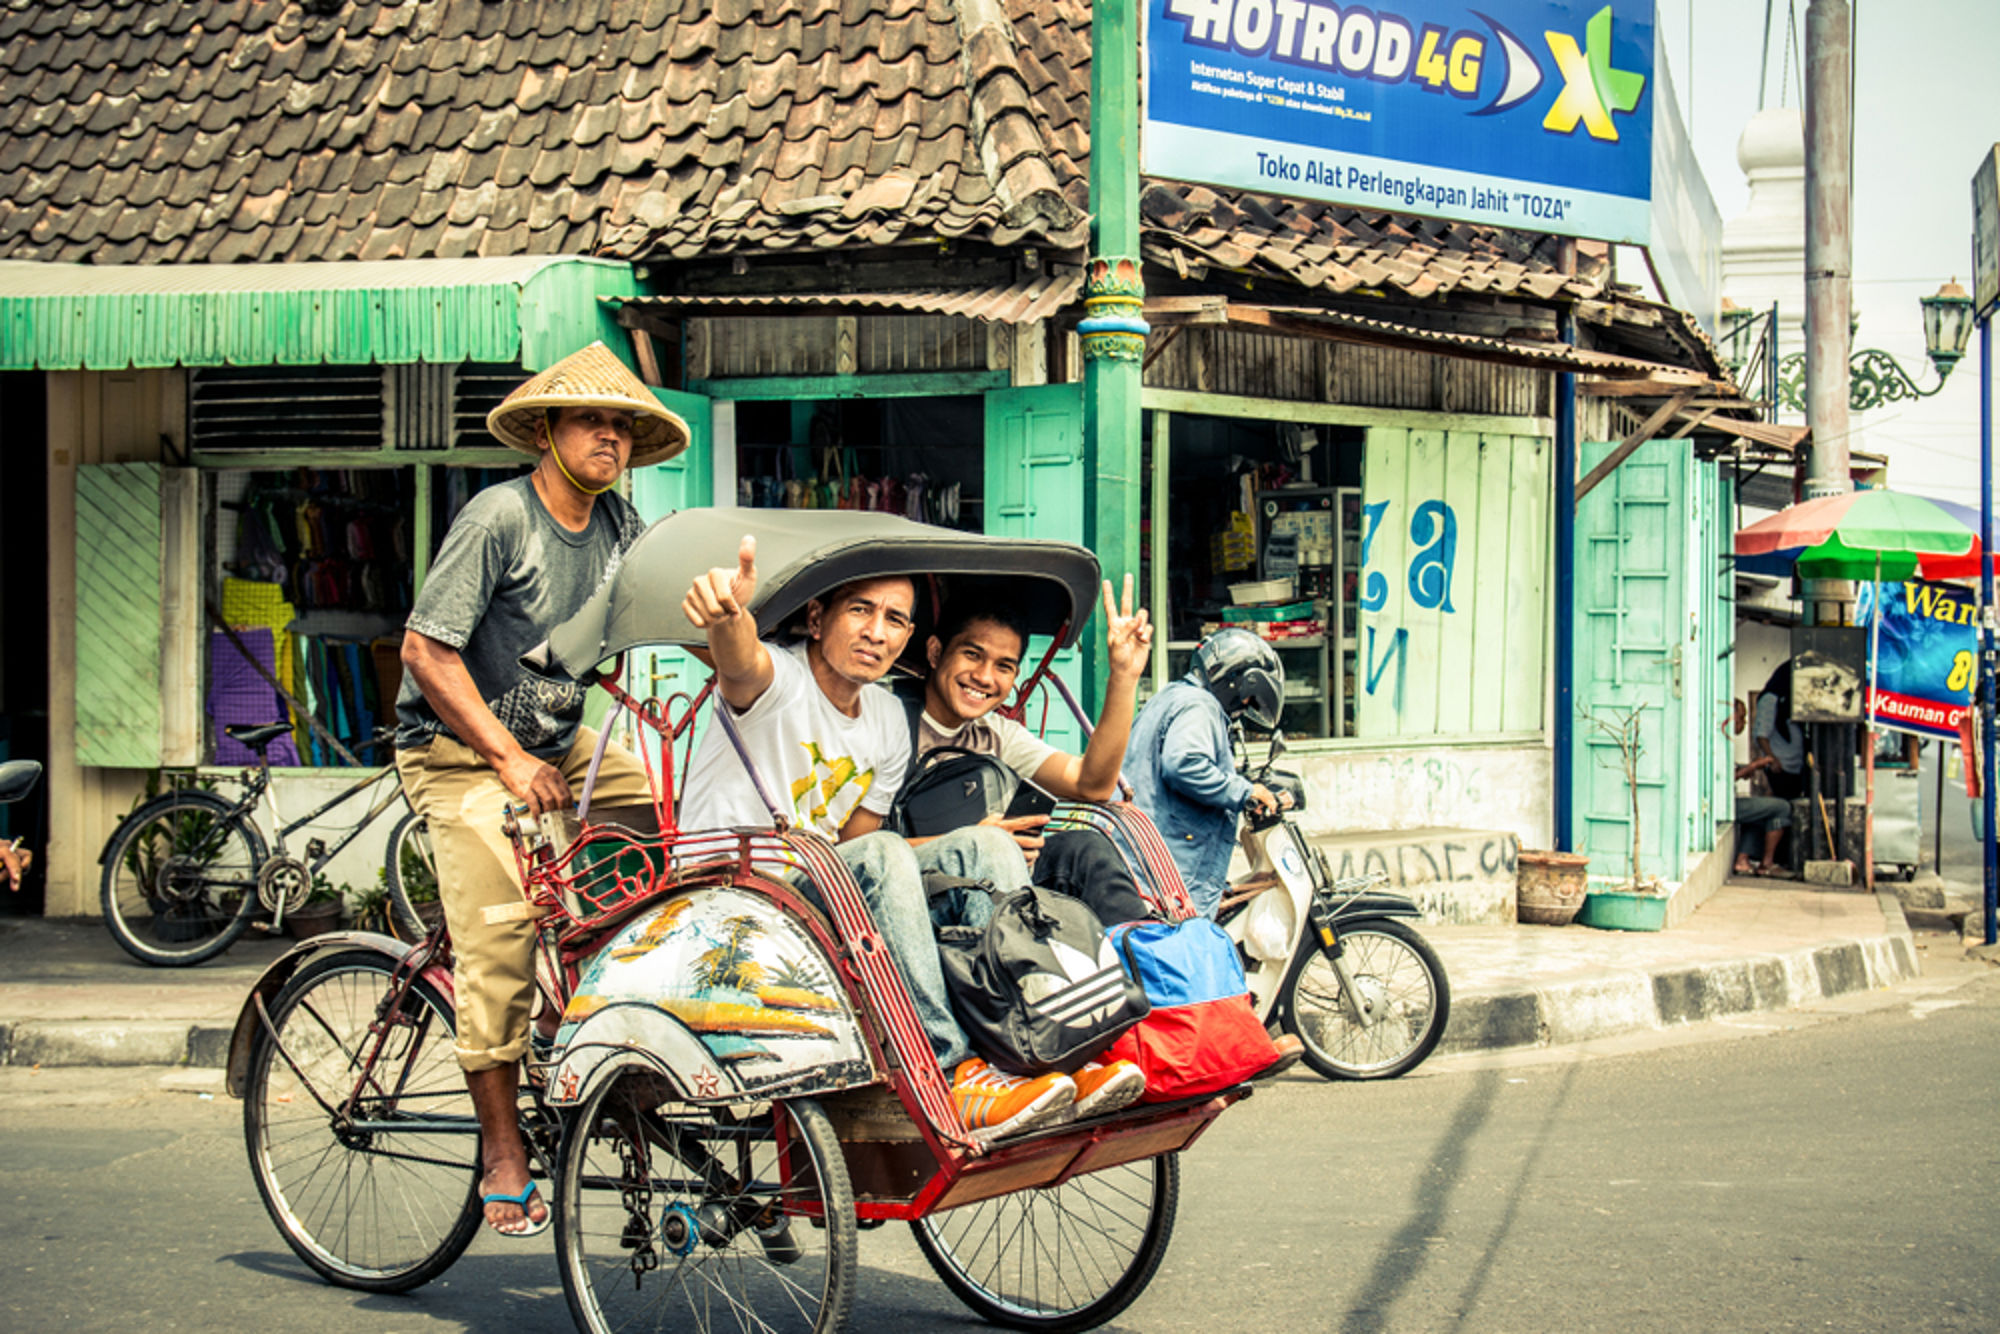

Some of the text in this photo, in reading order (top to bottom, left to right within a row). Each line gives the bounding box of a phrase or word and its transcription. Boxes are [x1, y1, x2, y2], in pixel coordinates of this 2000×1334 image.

[1170, 0, 1484, 92] HOTROD 4G
[1543, 4, 1645, 141] XL
[1190, 59, 1345, 102] Internetan Super Cepat & Stabil
[1257, 152, 1300, 181] Toko
[1305, 160, 1342, 189] Alat
[1347, 166, 1467, 209] Perlengkapan
[1470, 185, 1509, 213] Jahit
[1875, 694, 1945, 724] Kauman
